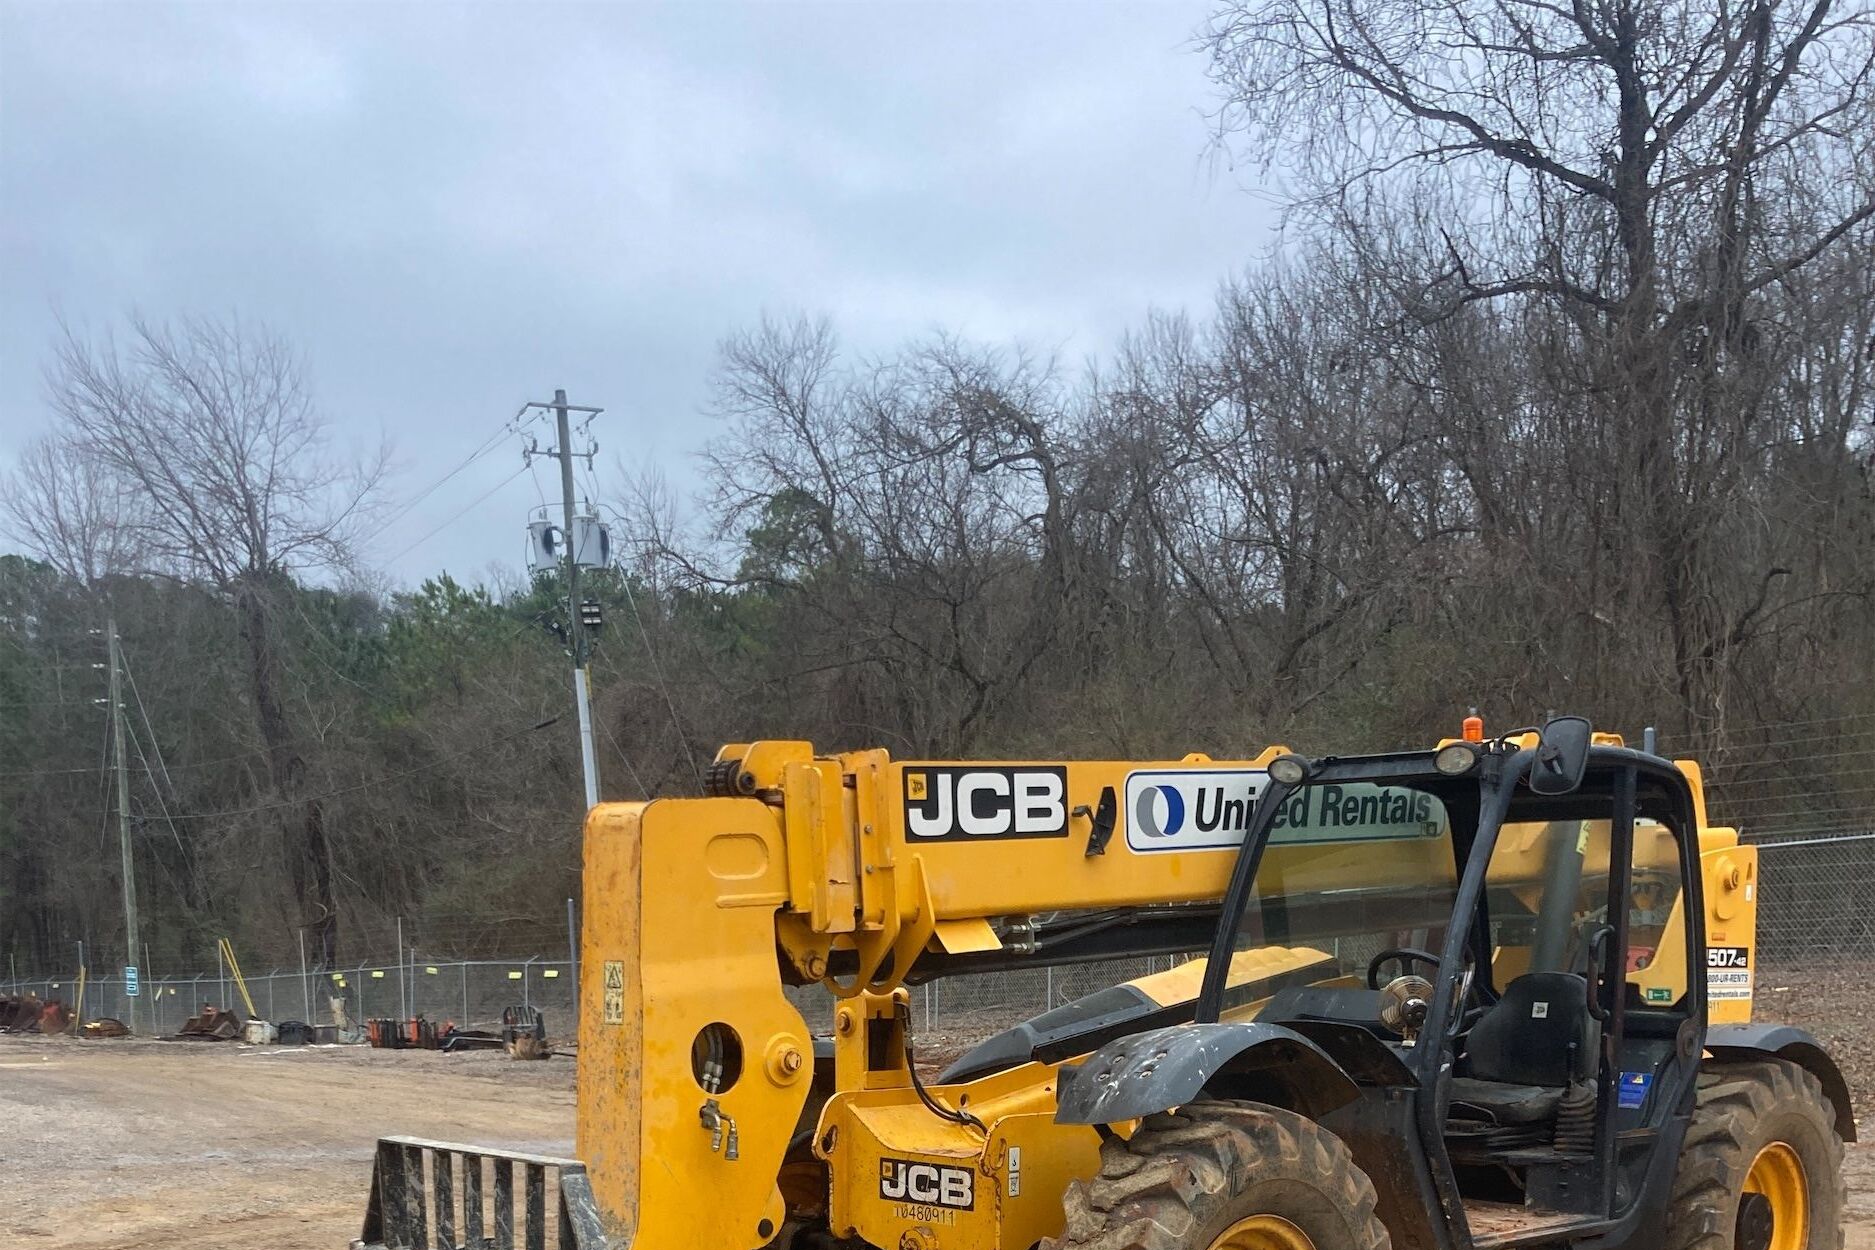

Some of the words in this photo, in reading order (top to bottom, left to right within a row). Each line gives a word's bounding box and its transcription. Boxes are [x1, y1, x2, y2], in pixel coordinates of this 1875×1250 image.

[908, 773, 1065, 836] JCB
[1195, 785, 1311, 832] Unied
[1319, 785, 1431, 827] Rentals
[1708, 949, 1746, 967] 507-42
[882, 1163, 972, 1206] JCB
